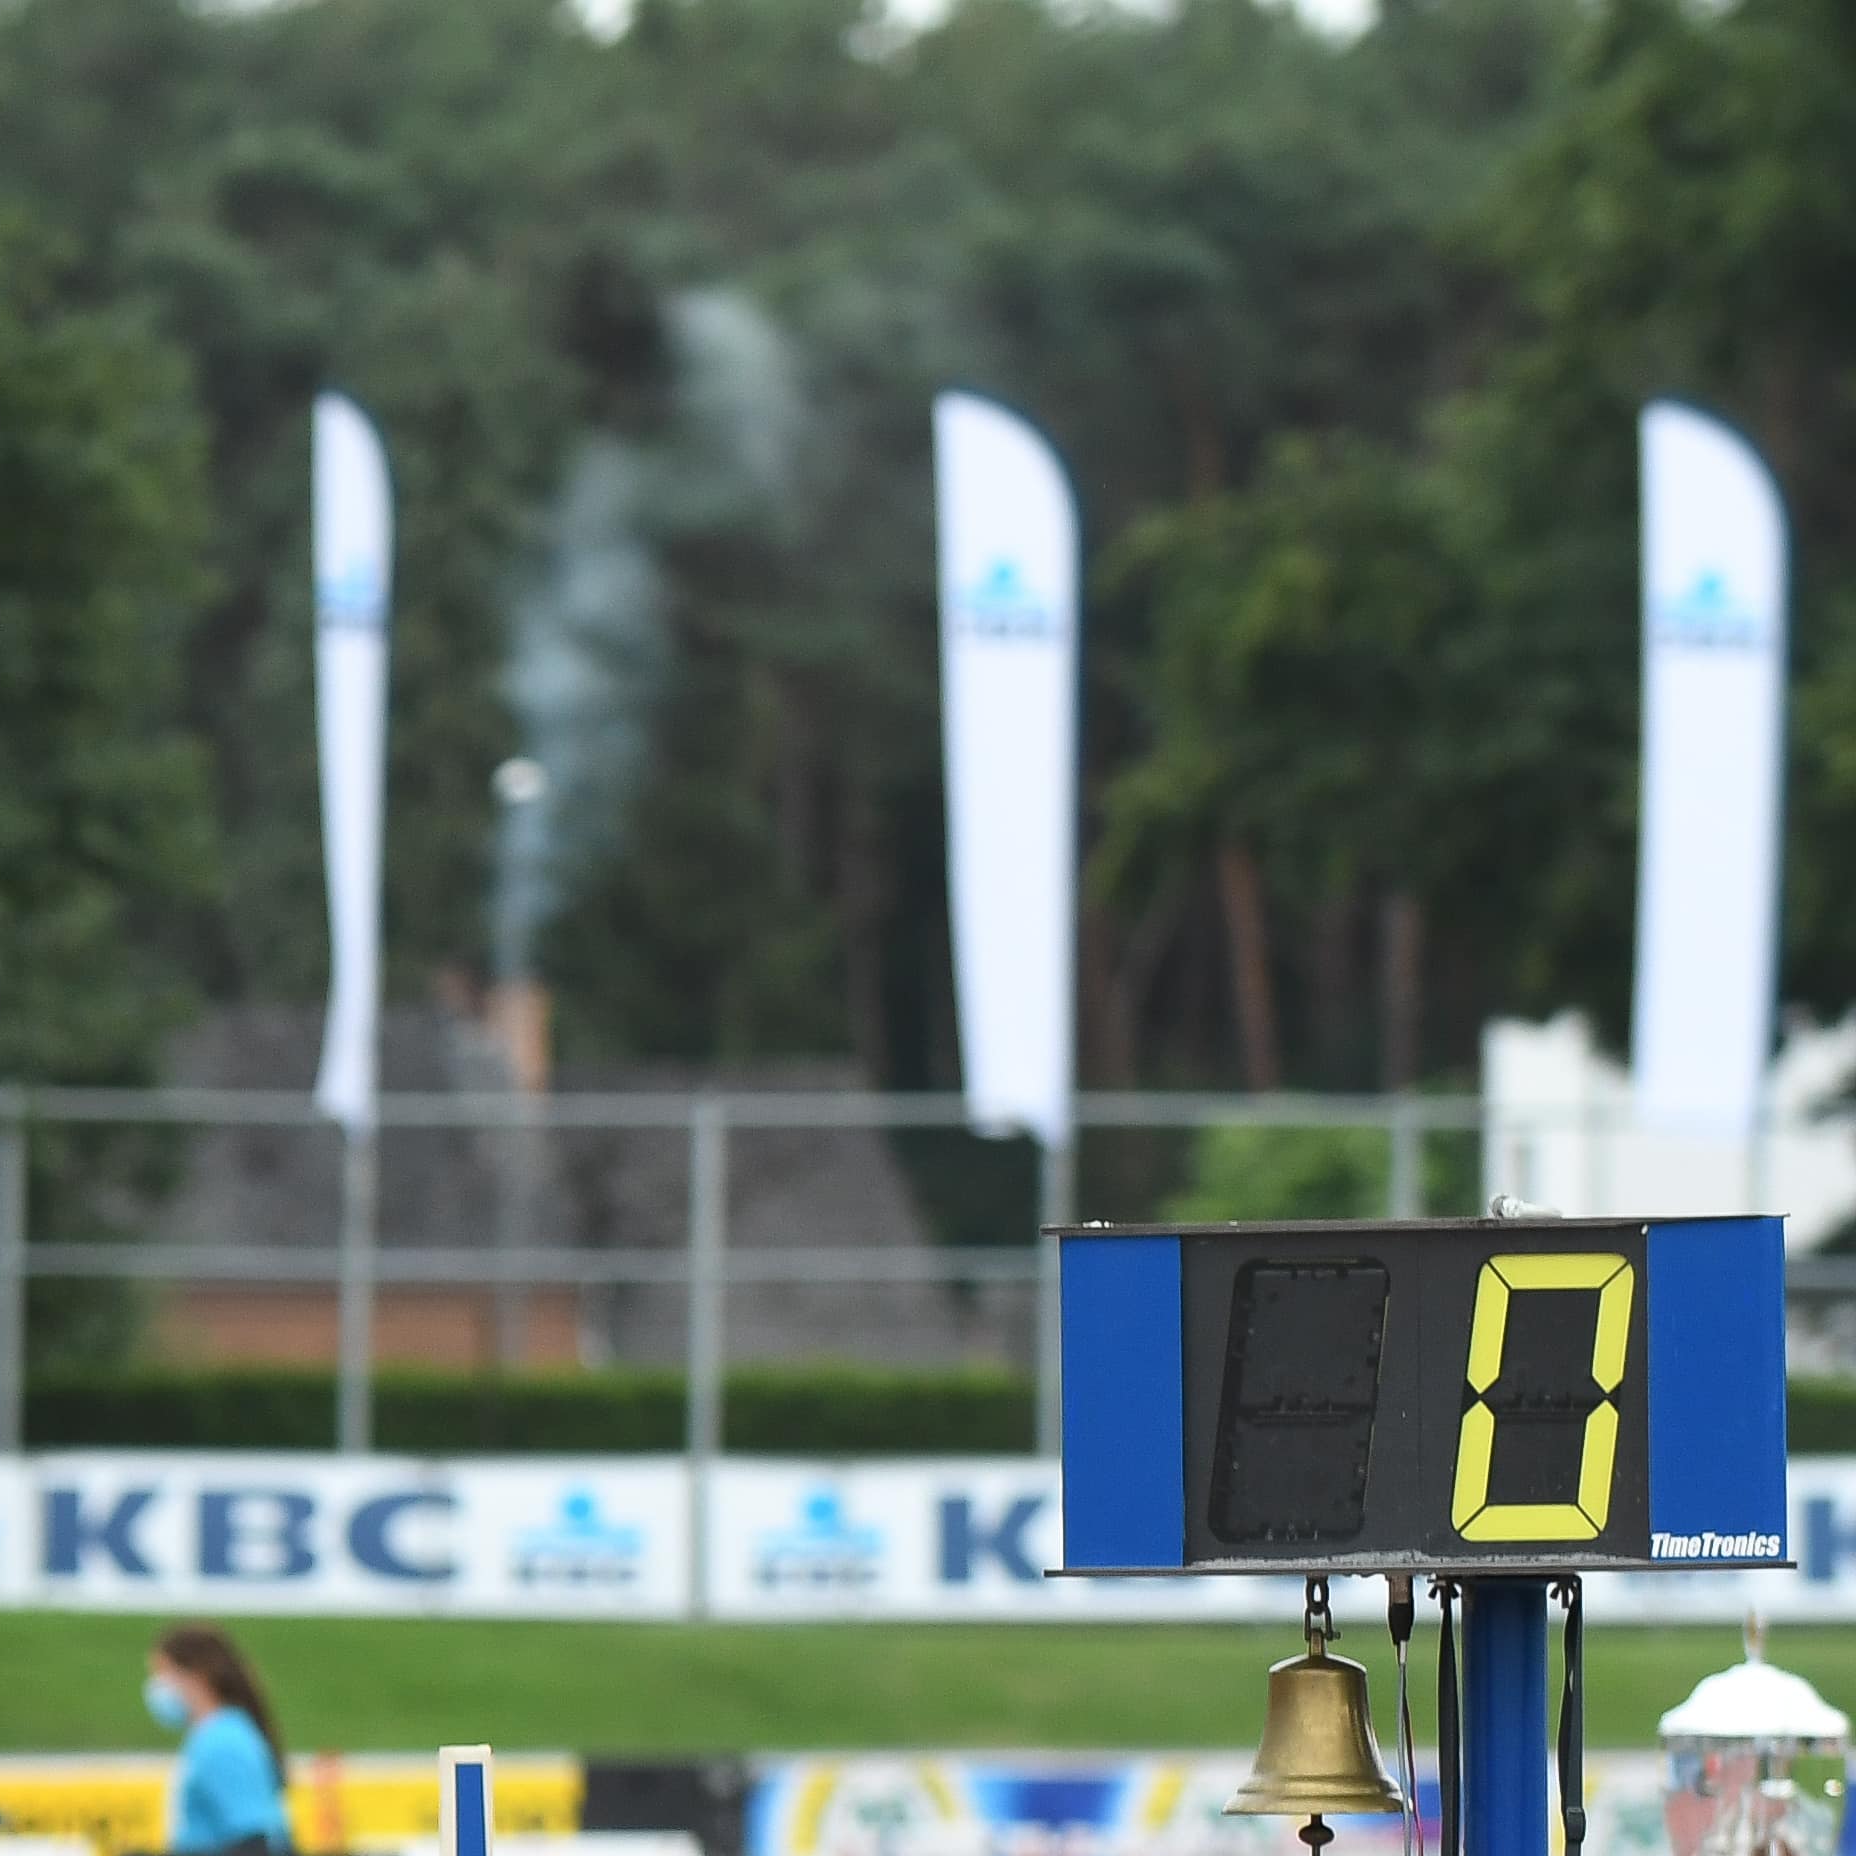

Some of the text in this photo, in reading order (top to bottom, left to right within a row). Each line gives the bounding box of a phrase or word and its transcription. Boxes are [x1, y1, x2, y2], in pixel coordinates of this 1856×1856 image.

[1451, 1253, 1636, 1544] 0
[44, 1490, 460, 1581] KBC
[1650, 1531, 1782, 1559] TimeTronics
